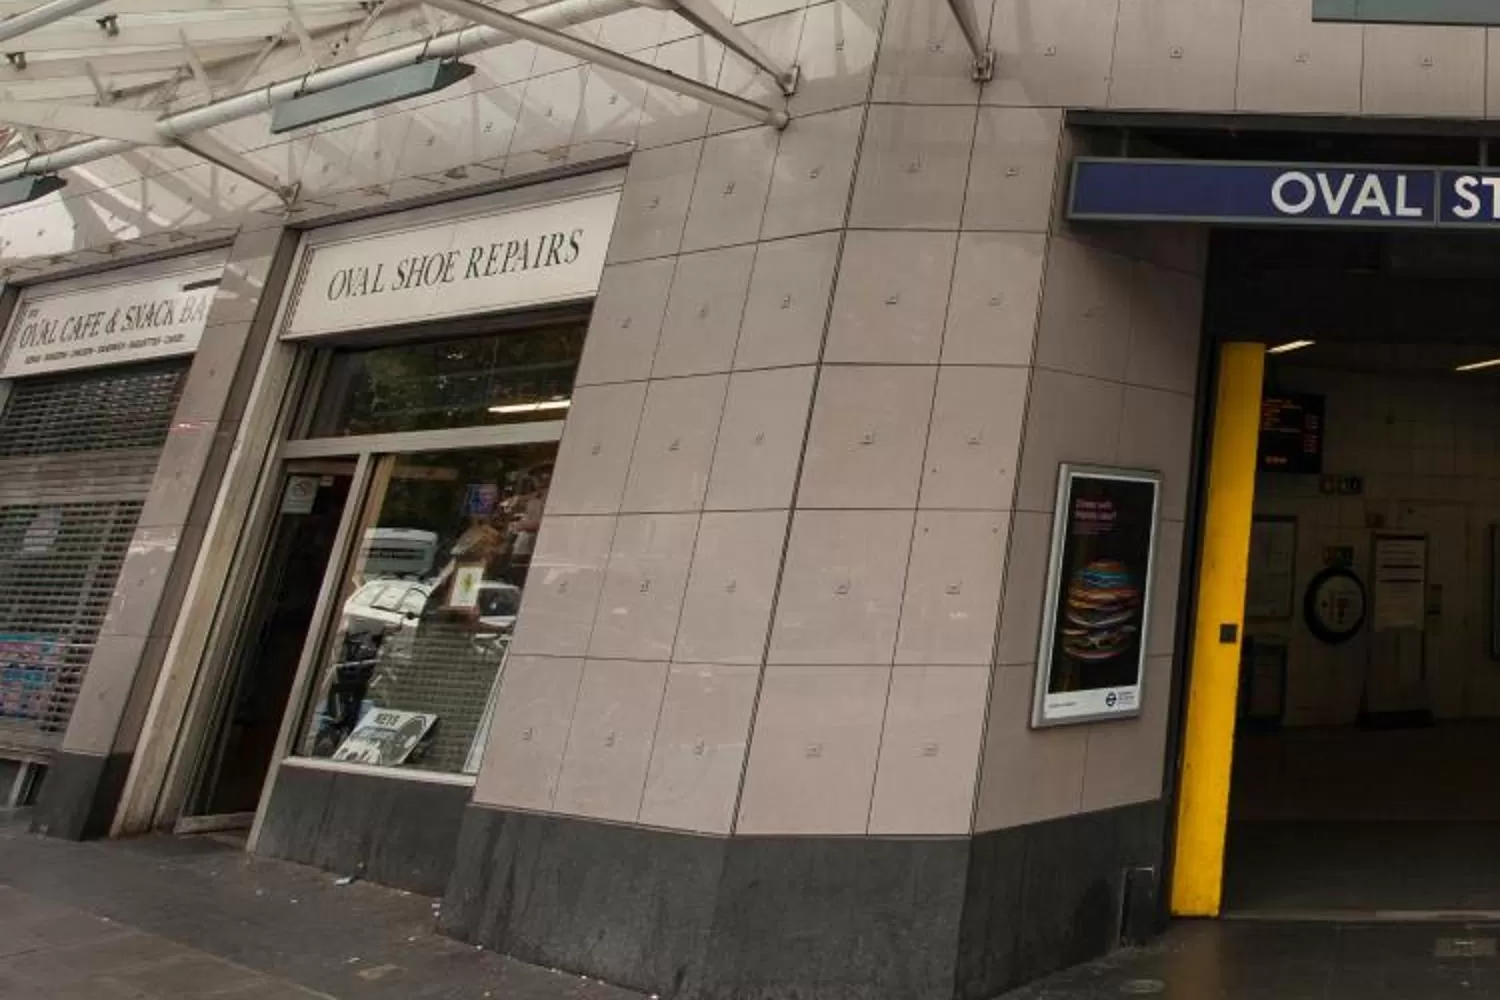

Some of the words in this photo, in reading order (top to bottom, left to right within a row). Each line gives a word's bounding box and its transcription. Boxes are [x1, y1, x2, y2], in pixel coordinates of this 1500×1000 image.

[1271, 171, 1423, 216] OVAL
[326, 263, 384, 301] OVAL
[391, 250, 460, 292] SHOE
[464, 228, 584, 280] REPAIRS
[18, 317, 57, 349] OVAL
[58, 311, 106, 344] CAFE
[120, 299, 174, 333] SNACK
[178, 294, 210, 324] BA
